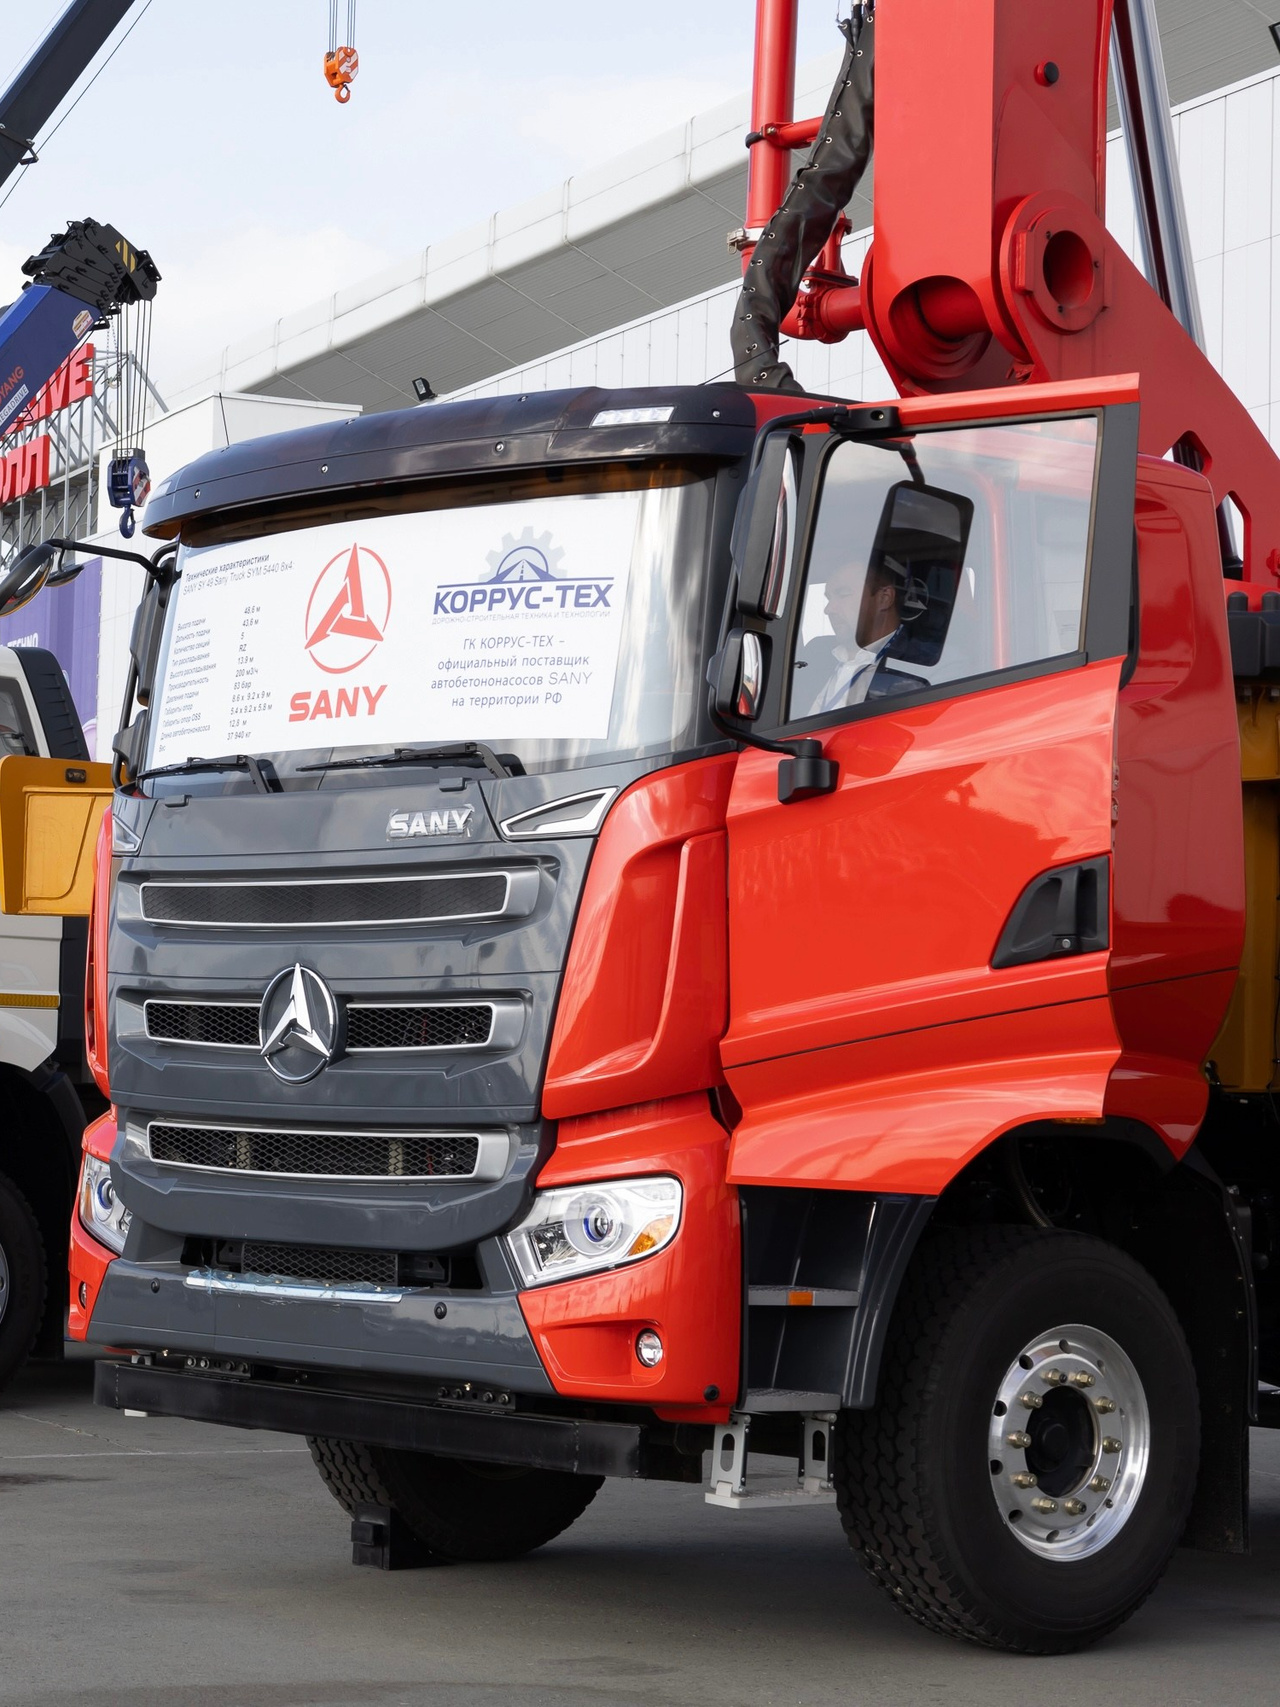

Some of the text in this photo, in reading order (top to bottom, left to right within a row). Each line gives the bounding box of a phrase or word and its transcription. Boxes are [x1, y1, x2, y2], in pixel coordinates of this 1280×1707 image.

[185, 554, 270, 582] Технические характеристики
[247, 566, 262, 579] SYM
[263, 564, 279, 576] 5440
[433, 584, 614, 615] КОРРУС-ТЕХ
[431, 612, 520, 625] ДОРОЖНО-СТРОИТЕЛЬНАЯ
[521, 611, 553, 621] ТЕХНИКА
[561, 610, 611, 619] ТЕХНОЛОГИИ
[239, 644, 247, 652] RZ
[463, 638, 476, 650] ГК
[480, 635, 554, 649] КОРРУС-ТЕХ
[438, 655, 589, 672] официальный поставщик
[431, 671, 593, 689] автобетононасосов SANY
[289, 684, 388, 722] SANY
[452, 692, 562, 708] на территории РФ
[388, 804, 474, 839] SANY
